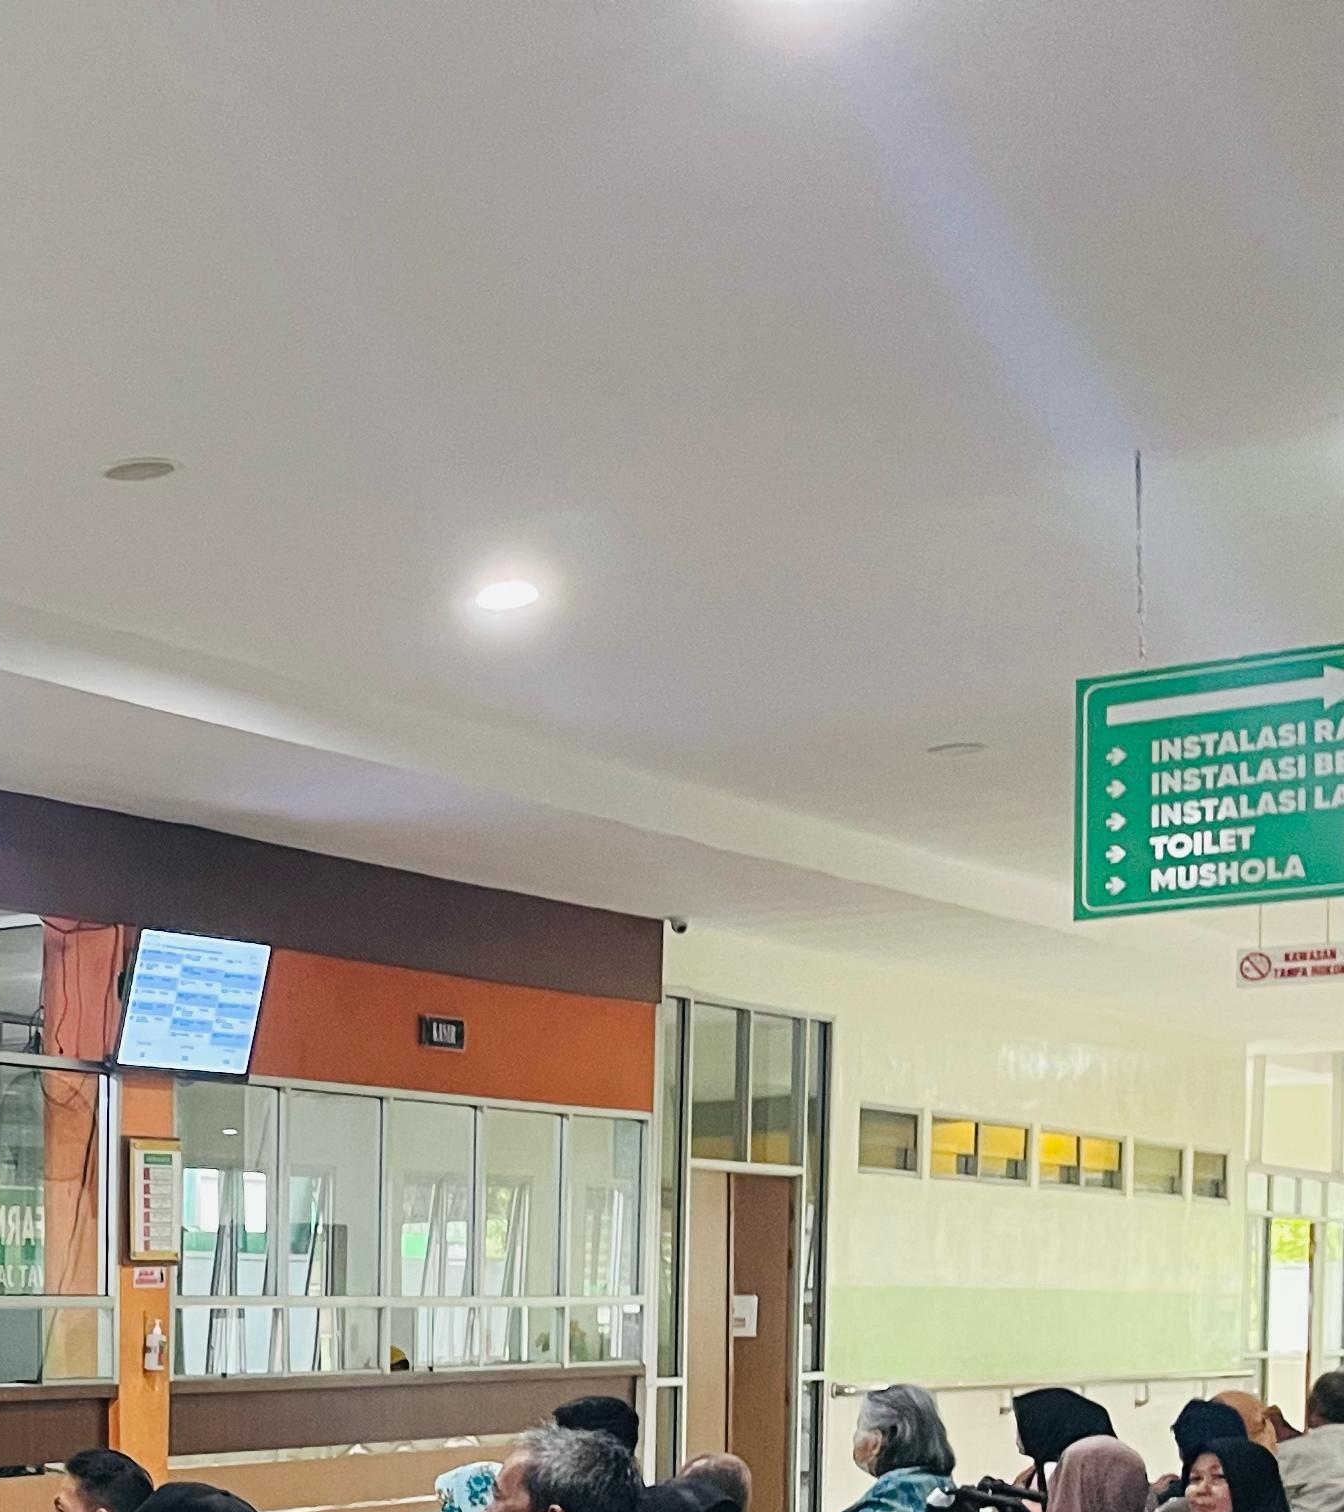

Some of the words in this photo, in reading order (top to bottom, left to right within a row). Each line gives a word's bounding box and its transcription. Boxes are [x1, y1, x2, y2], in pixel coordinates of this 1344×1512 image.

[1151, 721, 1307, 764] INSTALASI
[1151, 753, 1307, 796] INSTALASI
[1151, 787, 1307, 828] INSTALASI
[1149, 826, 1256, 861] TOILET
[1150, 854, 1306, 893] MUSHOLA
